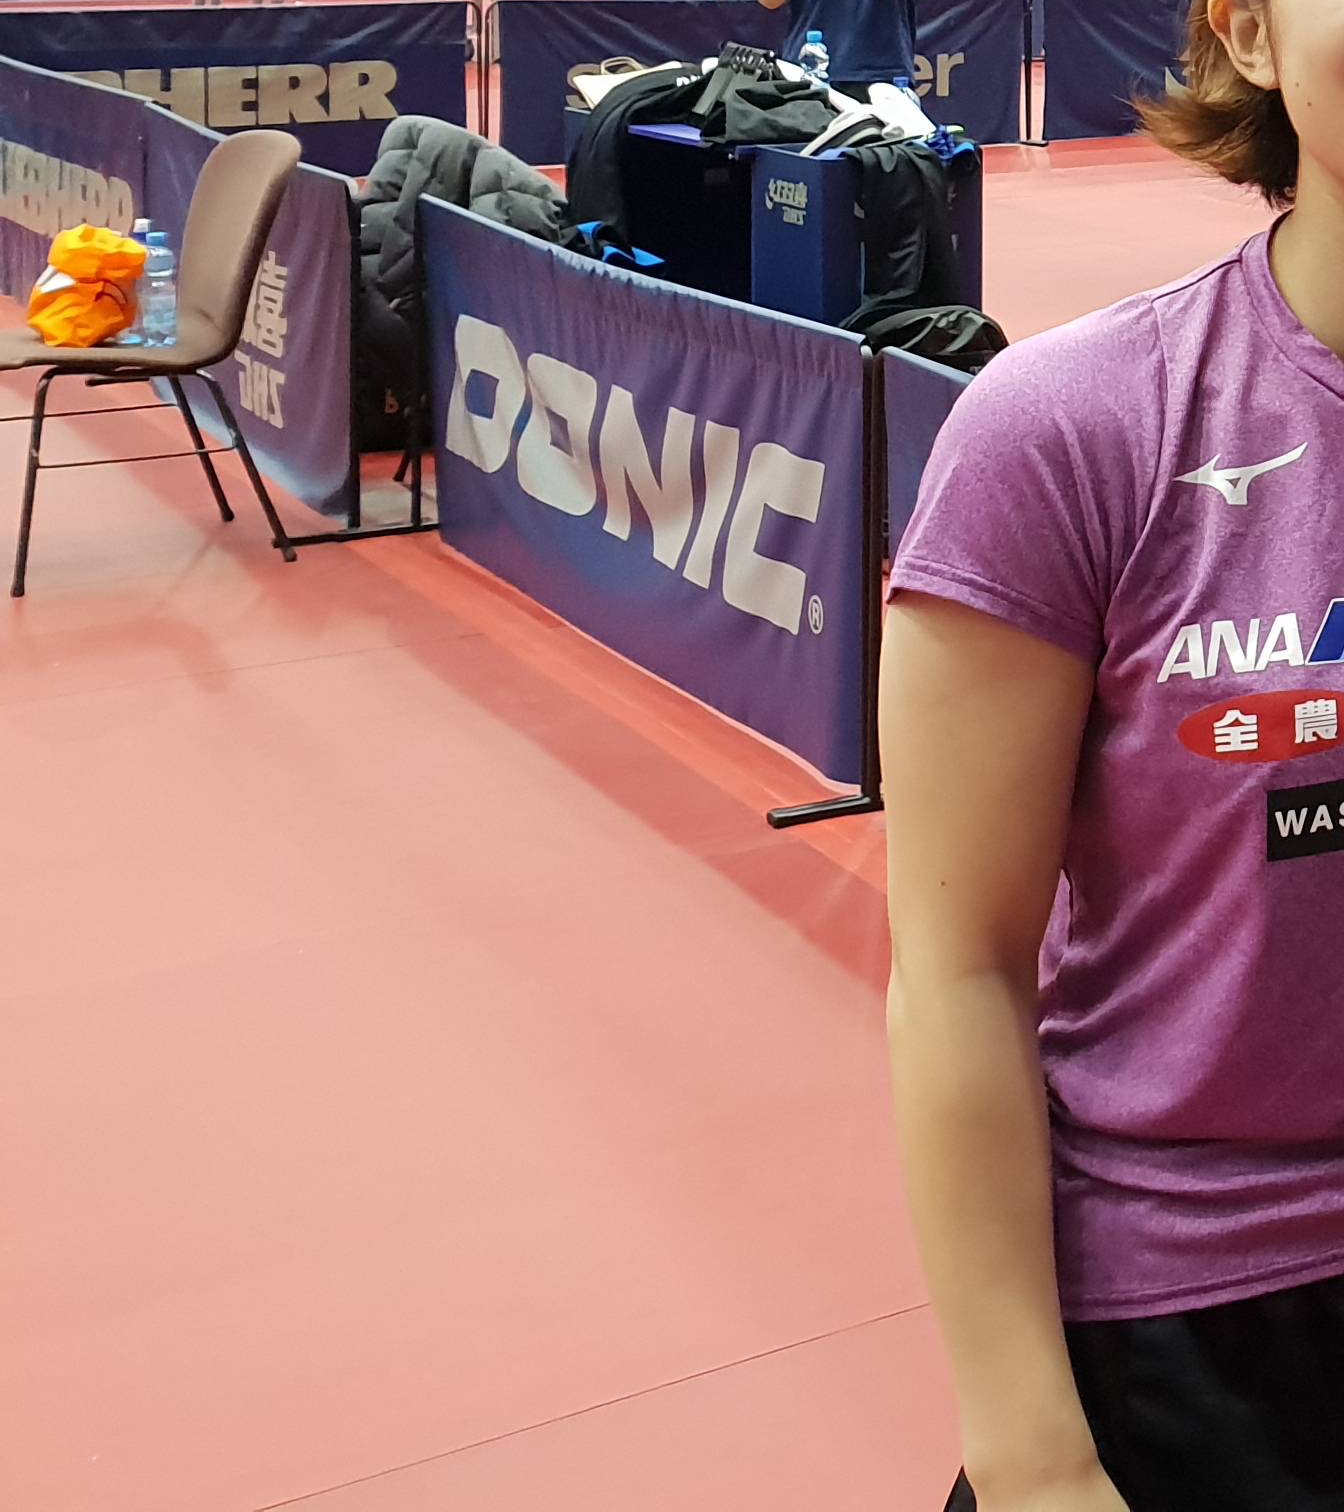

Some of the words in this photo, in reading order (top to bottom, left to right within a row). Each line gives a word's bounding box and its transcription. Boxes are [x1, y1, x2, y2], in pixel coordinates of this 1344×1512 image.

[446, 314, 826, 635] DONIC
[1156, 612, 1306, 683] ANA
[1213, 698, 1338, 753] 全農
